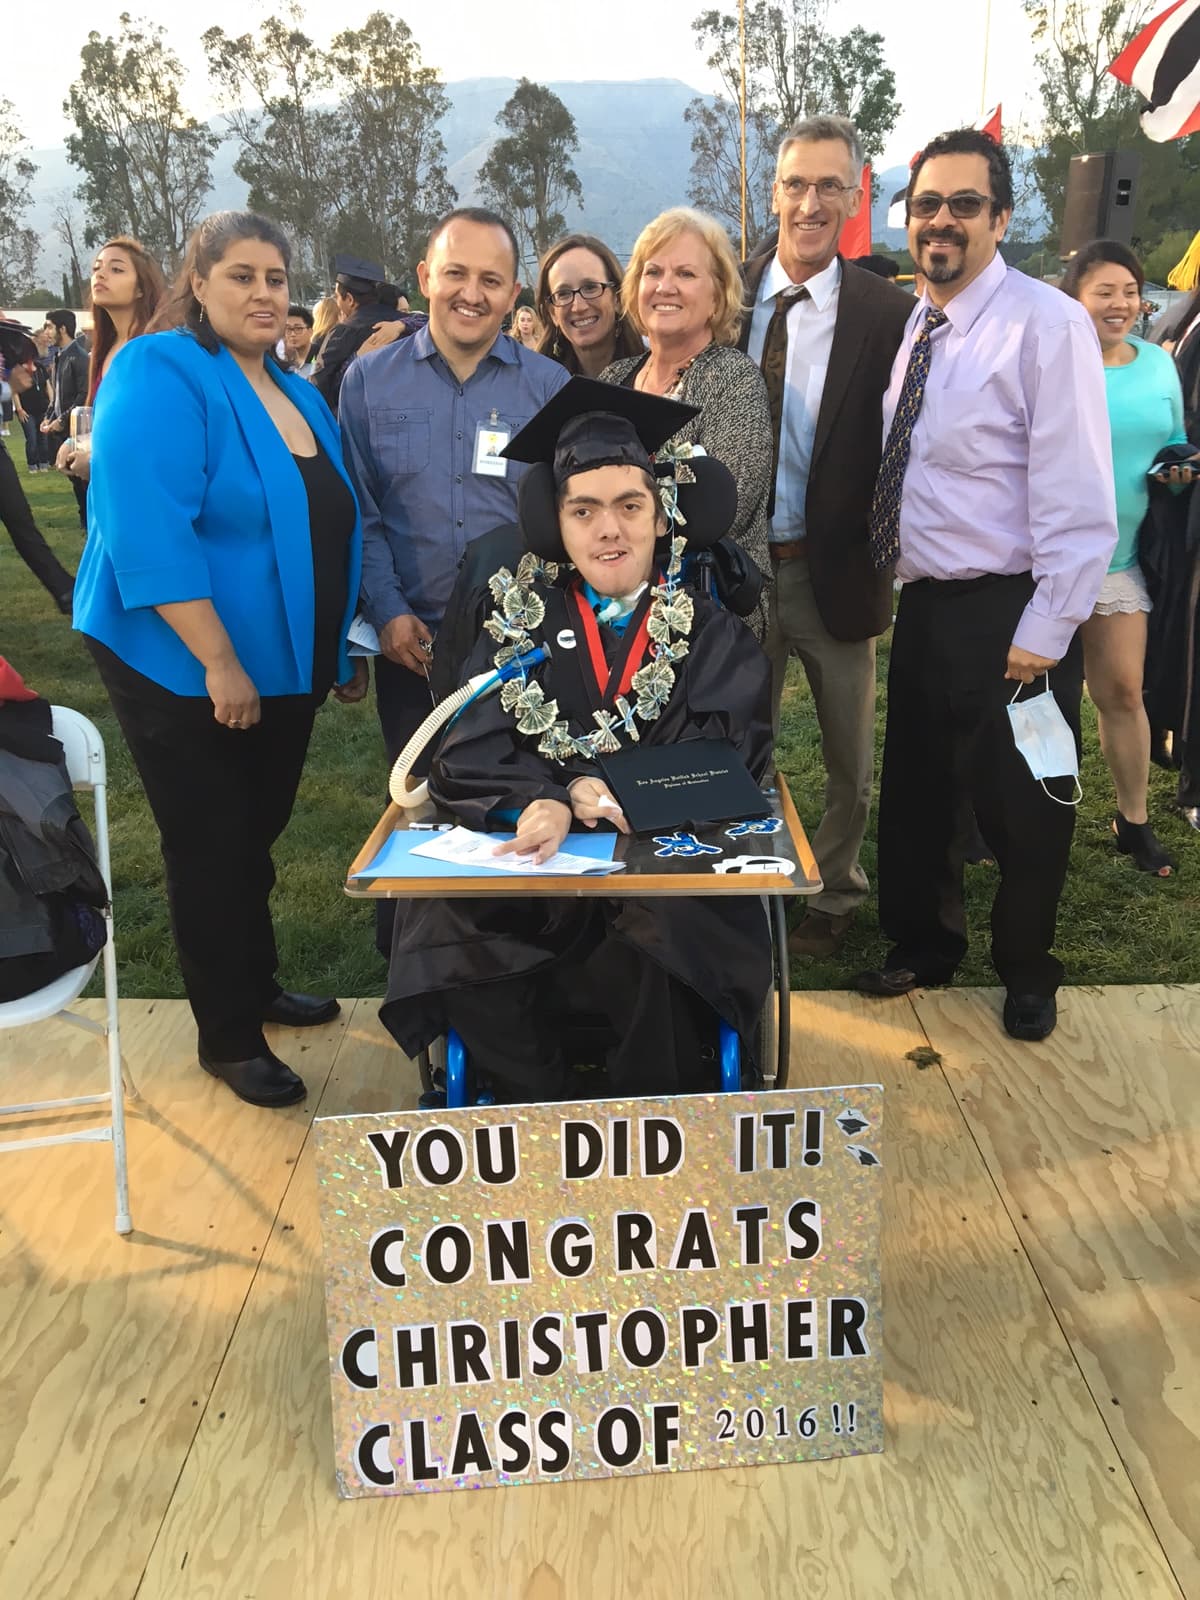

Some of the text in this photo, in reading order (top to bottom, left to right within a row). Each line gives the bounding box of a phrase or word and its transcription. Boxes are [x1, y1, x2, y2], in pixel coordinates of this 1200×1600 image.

[369, 1110, 825, 1189] YOU DID IT!
[370, 1200, 823, 1287] CONGRATS
[341, 1298, 868, 1390] CHRISTOPHER
[357, 1409, 572, 1486] CLASS
[598, 1404, 680, 1469] OF
[716, 1405, 818, 1442] 2016
